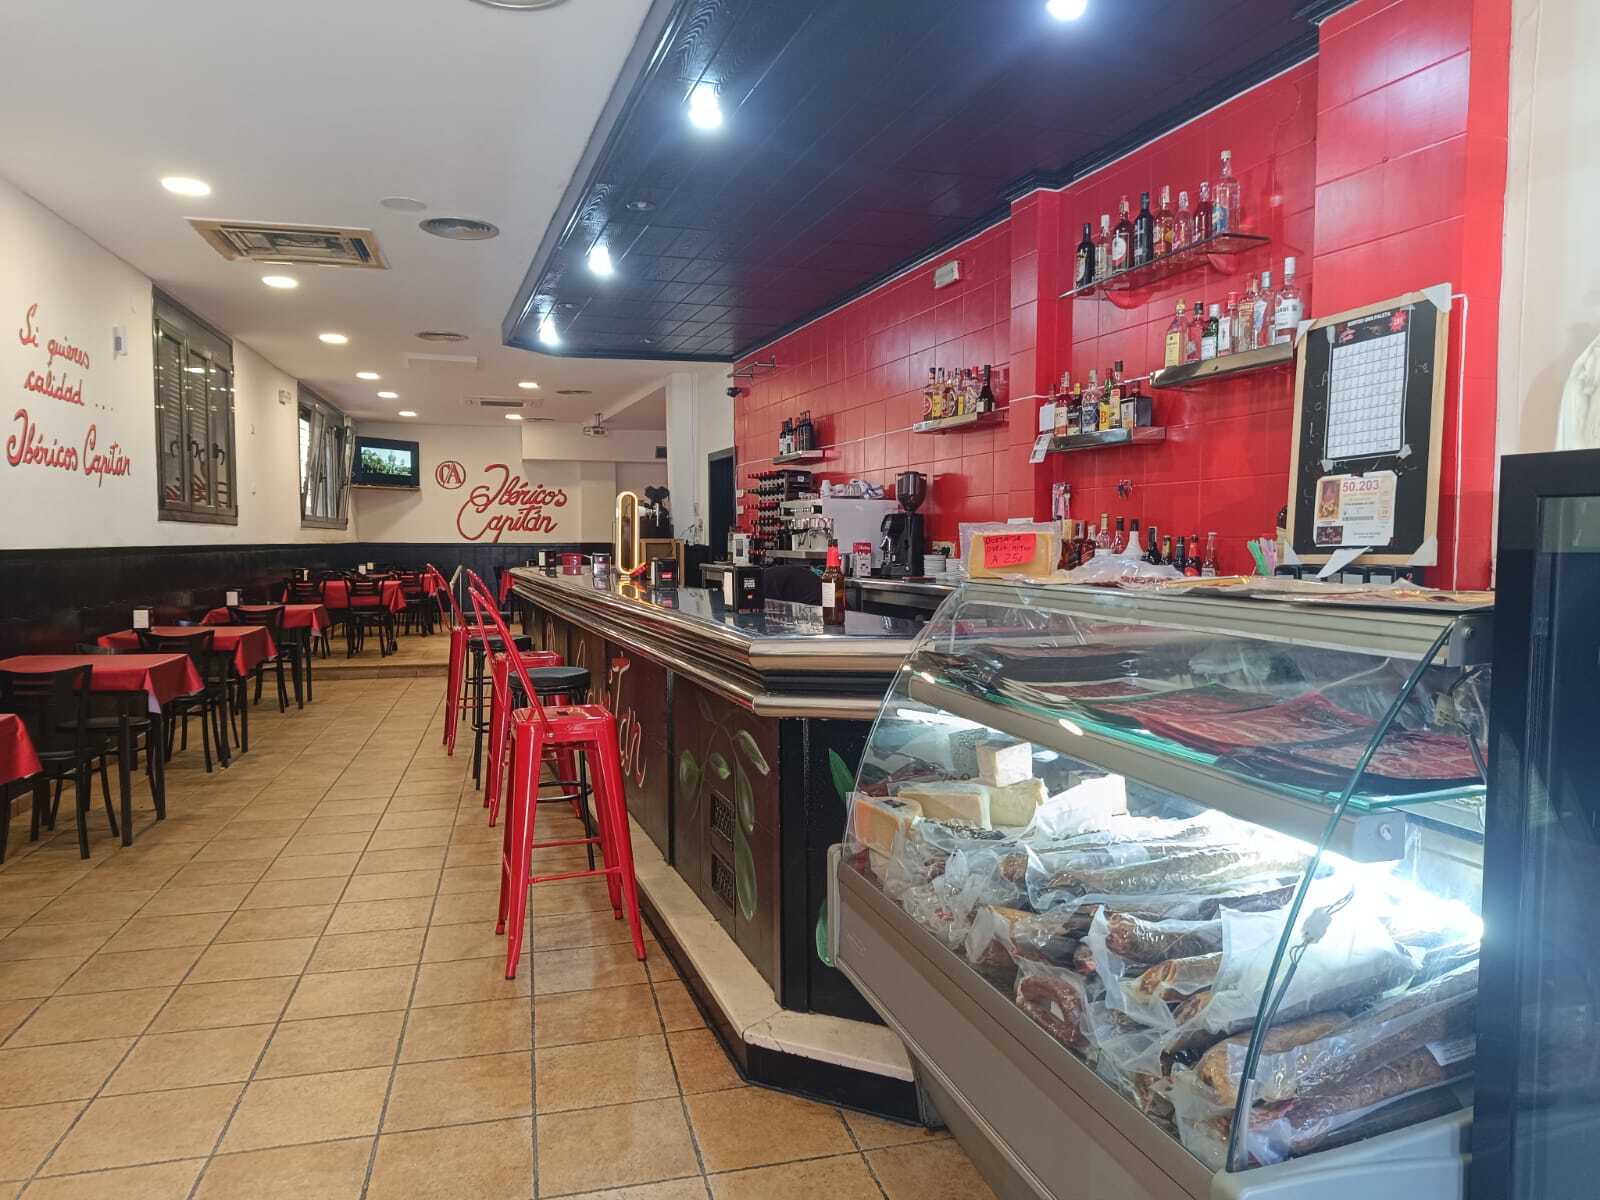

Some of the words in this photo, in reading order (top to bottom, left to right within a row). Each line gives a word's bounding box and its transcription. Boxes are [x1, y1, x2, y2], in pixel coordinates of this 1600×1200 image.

[19, 303, 39, 348] Si
[47, 336, 90, 370] quieres
[24, 370, 85, 406] calidad
[6, 408, 79, 472] Ibéricos
[83, 423, 131, 488] Capitán
[475, 463, 568, 514] Ibéricos
[1342, 480, 1380, 493] 50.203
[456, 485, 558, 544] Capitán
